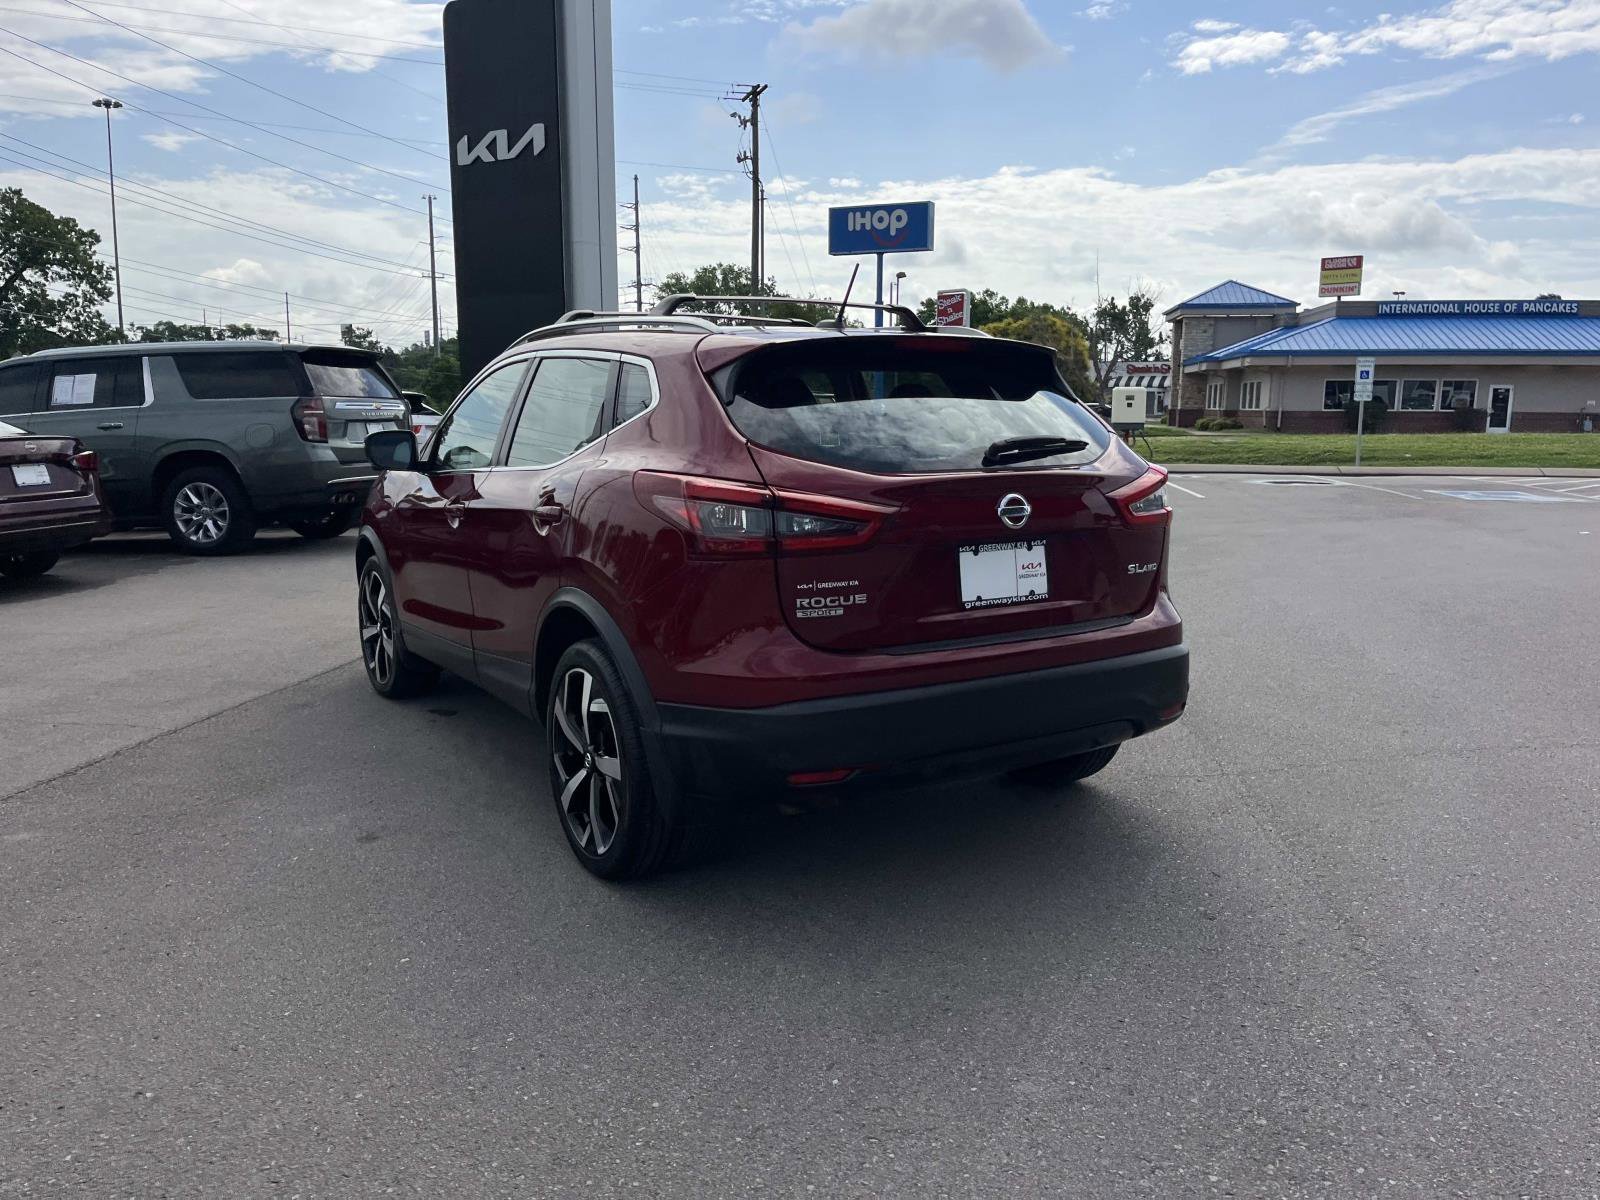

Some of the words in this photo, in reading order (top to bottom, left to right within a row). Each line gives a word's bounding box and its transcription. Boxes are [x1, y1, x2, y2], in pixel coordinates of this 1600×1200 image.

[456, 122, 546, 166] KIA
[847, 208, 909, 237] IHOP
[1378, 303, 1460, 314] INTERNATIONAL
[1464, 303, 1500, 313] HOUSE
[1503, 303, 1518, 313] OF
[1522, 302, 1578, 313] PANCAKES
[978, 543, 1016, 552] GREENWAY
[1021, 562, 1042, 570] KIA
[817, 581, 849, 589] GREENWAY
[796, 594, 867, 608] ROGUE
[964, 593, 1049, 609] greenwaykia.com
[801, 609, 839, 617] SPORT
